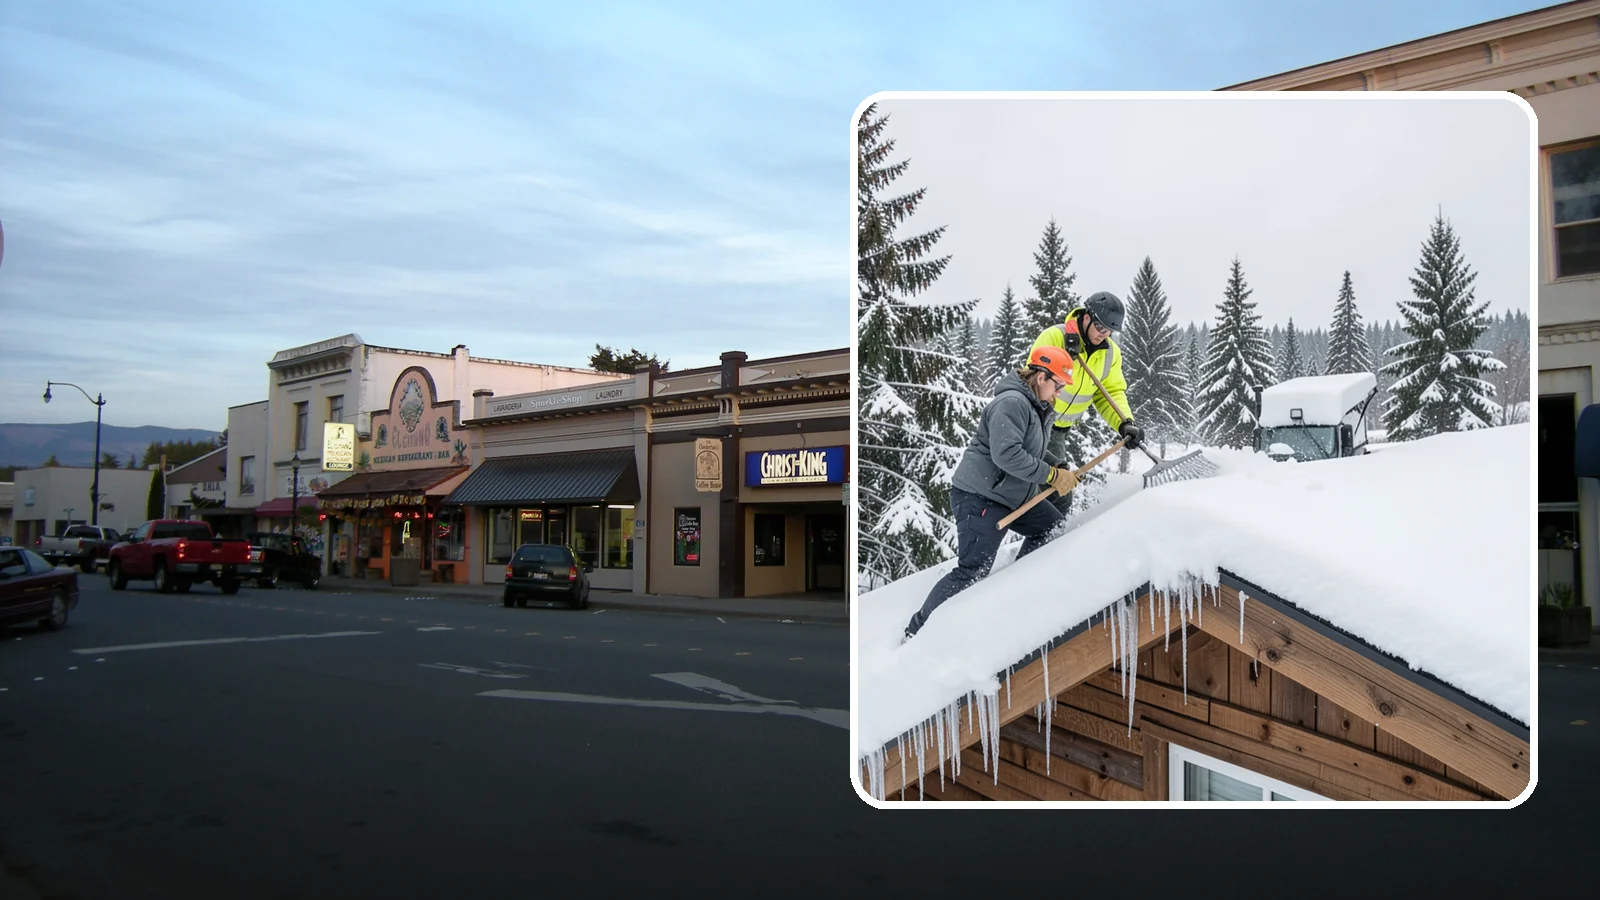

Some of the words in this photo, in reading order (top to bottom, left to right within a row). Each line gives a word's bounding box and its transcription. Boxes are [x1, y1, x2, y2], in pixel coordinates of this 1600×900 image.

[493, 402, 522, 412] LAVANDERIA
[562, 394, 582, 404] Shop
[596, 389, 623, 400] LAUNDRY
[373, 454, 396, 464] MEXICAN
[398, 451, 433, 462] RESTAURANT
[438, 450, 450, 459] BAR
[761, 452, 797, 478] CHRIST
[799, 450, 827, 476] KING
